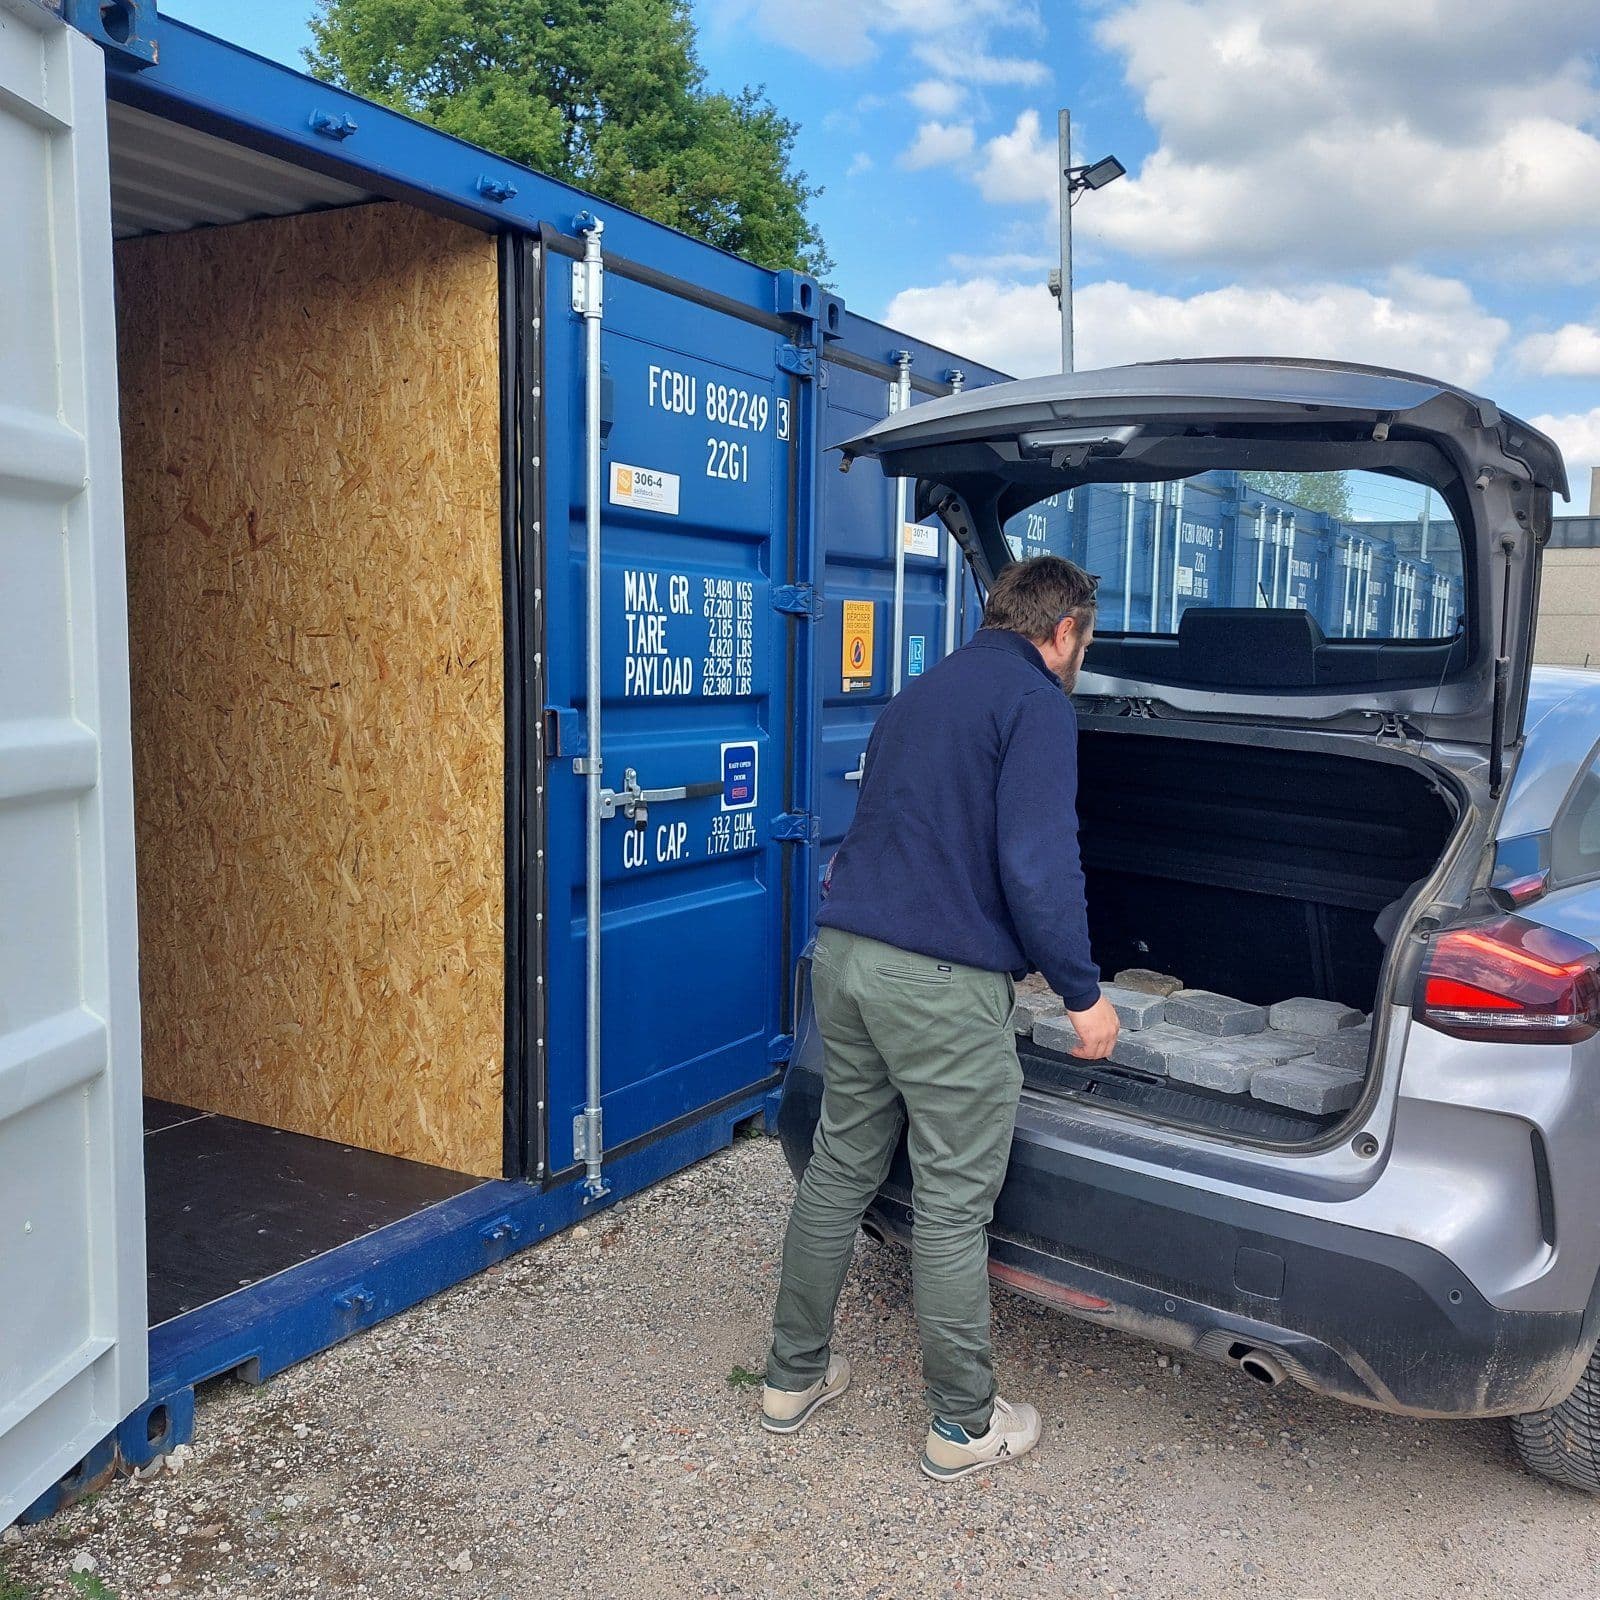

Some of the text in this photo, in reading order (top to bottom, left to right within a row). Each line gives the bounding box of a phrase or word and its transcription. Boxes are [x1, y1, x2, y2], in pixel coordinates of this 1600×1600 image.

[649, 365, 789, 438] FCBU 882249 3
[706, 438, 747, 483] 22G1
[634, 472, 663, 489] 306-4
[913, 527, 929, 539] 307-1
[1027, 513, 1047, 543] 22G1
[624, 570, 693, 615] MAX. GR.
[702, 577, 753, 601] 30.480 KGS
[703, 599, 753, 620] 67.200 LBS
[625, 613, 668, 655] TARE
[708, 619, 753, 639] 2.185 KGS
[708, 639, 753, 658] 4.820 LBS
[625, 656, 693, 696] PAYLOAD
[702, 657, 753, 677] 28.295 KGS
[702, 677, 752, 696] 62.380 LBS
[711, 815, 731, 835] 33.2
[623, 822, 689, 869] CU. CAP.
